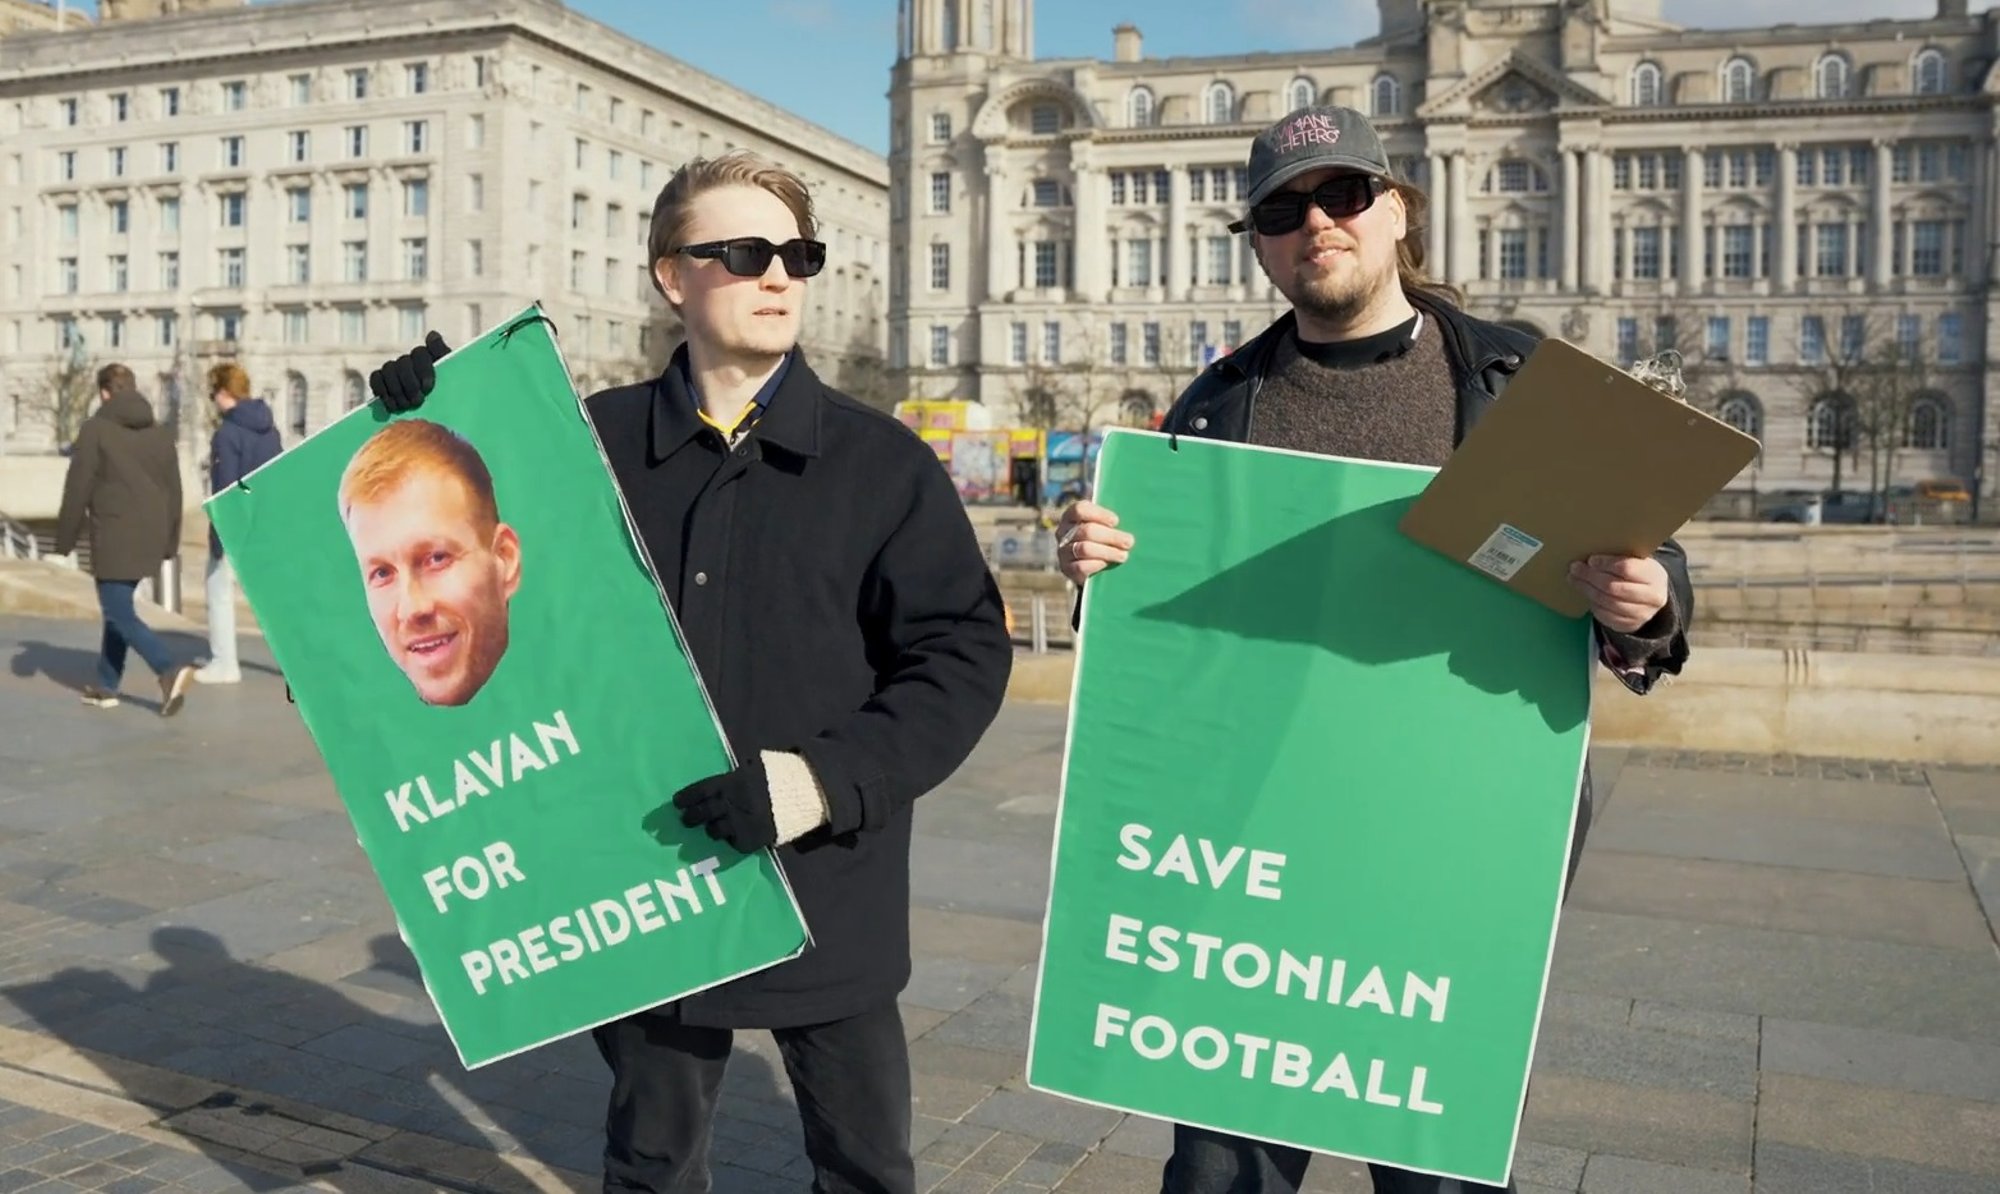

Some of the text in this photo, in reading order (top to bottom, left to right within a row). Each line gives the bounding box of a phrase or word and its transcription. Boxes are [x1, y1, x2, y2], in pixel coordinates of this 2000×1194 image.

[384, 710, 580, 832] KLAVAN
[422, 841, 526, 914] FOR
[1116, 823, 1287, 900] SAVE
[460, 856, 727, 995] PRESIDENT
[1105, 914, 1450, 1023] ESTONIAN
[1093, 1003, 1444, 1115] FOOTBALL
